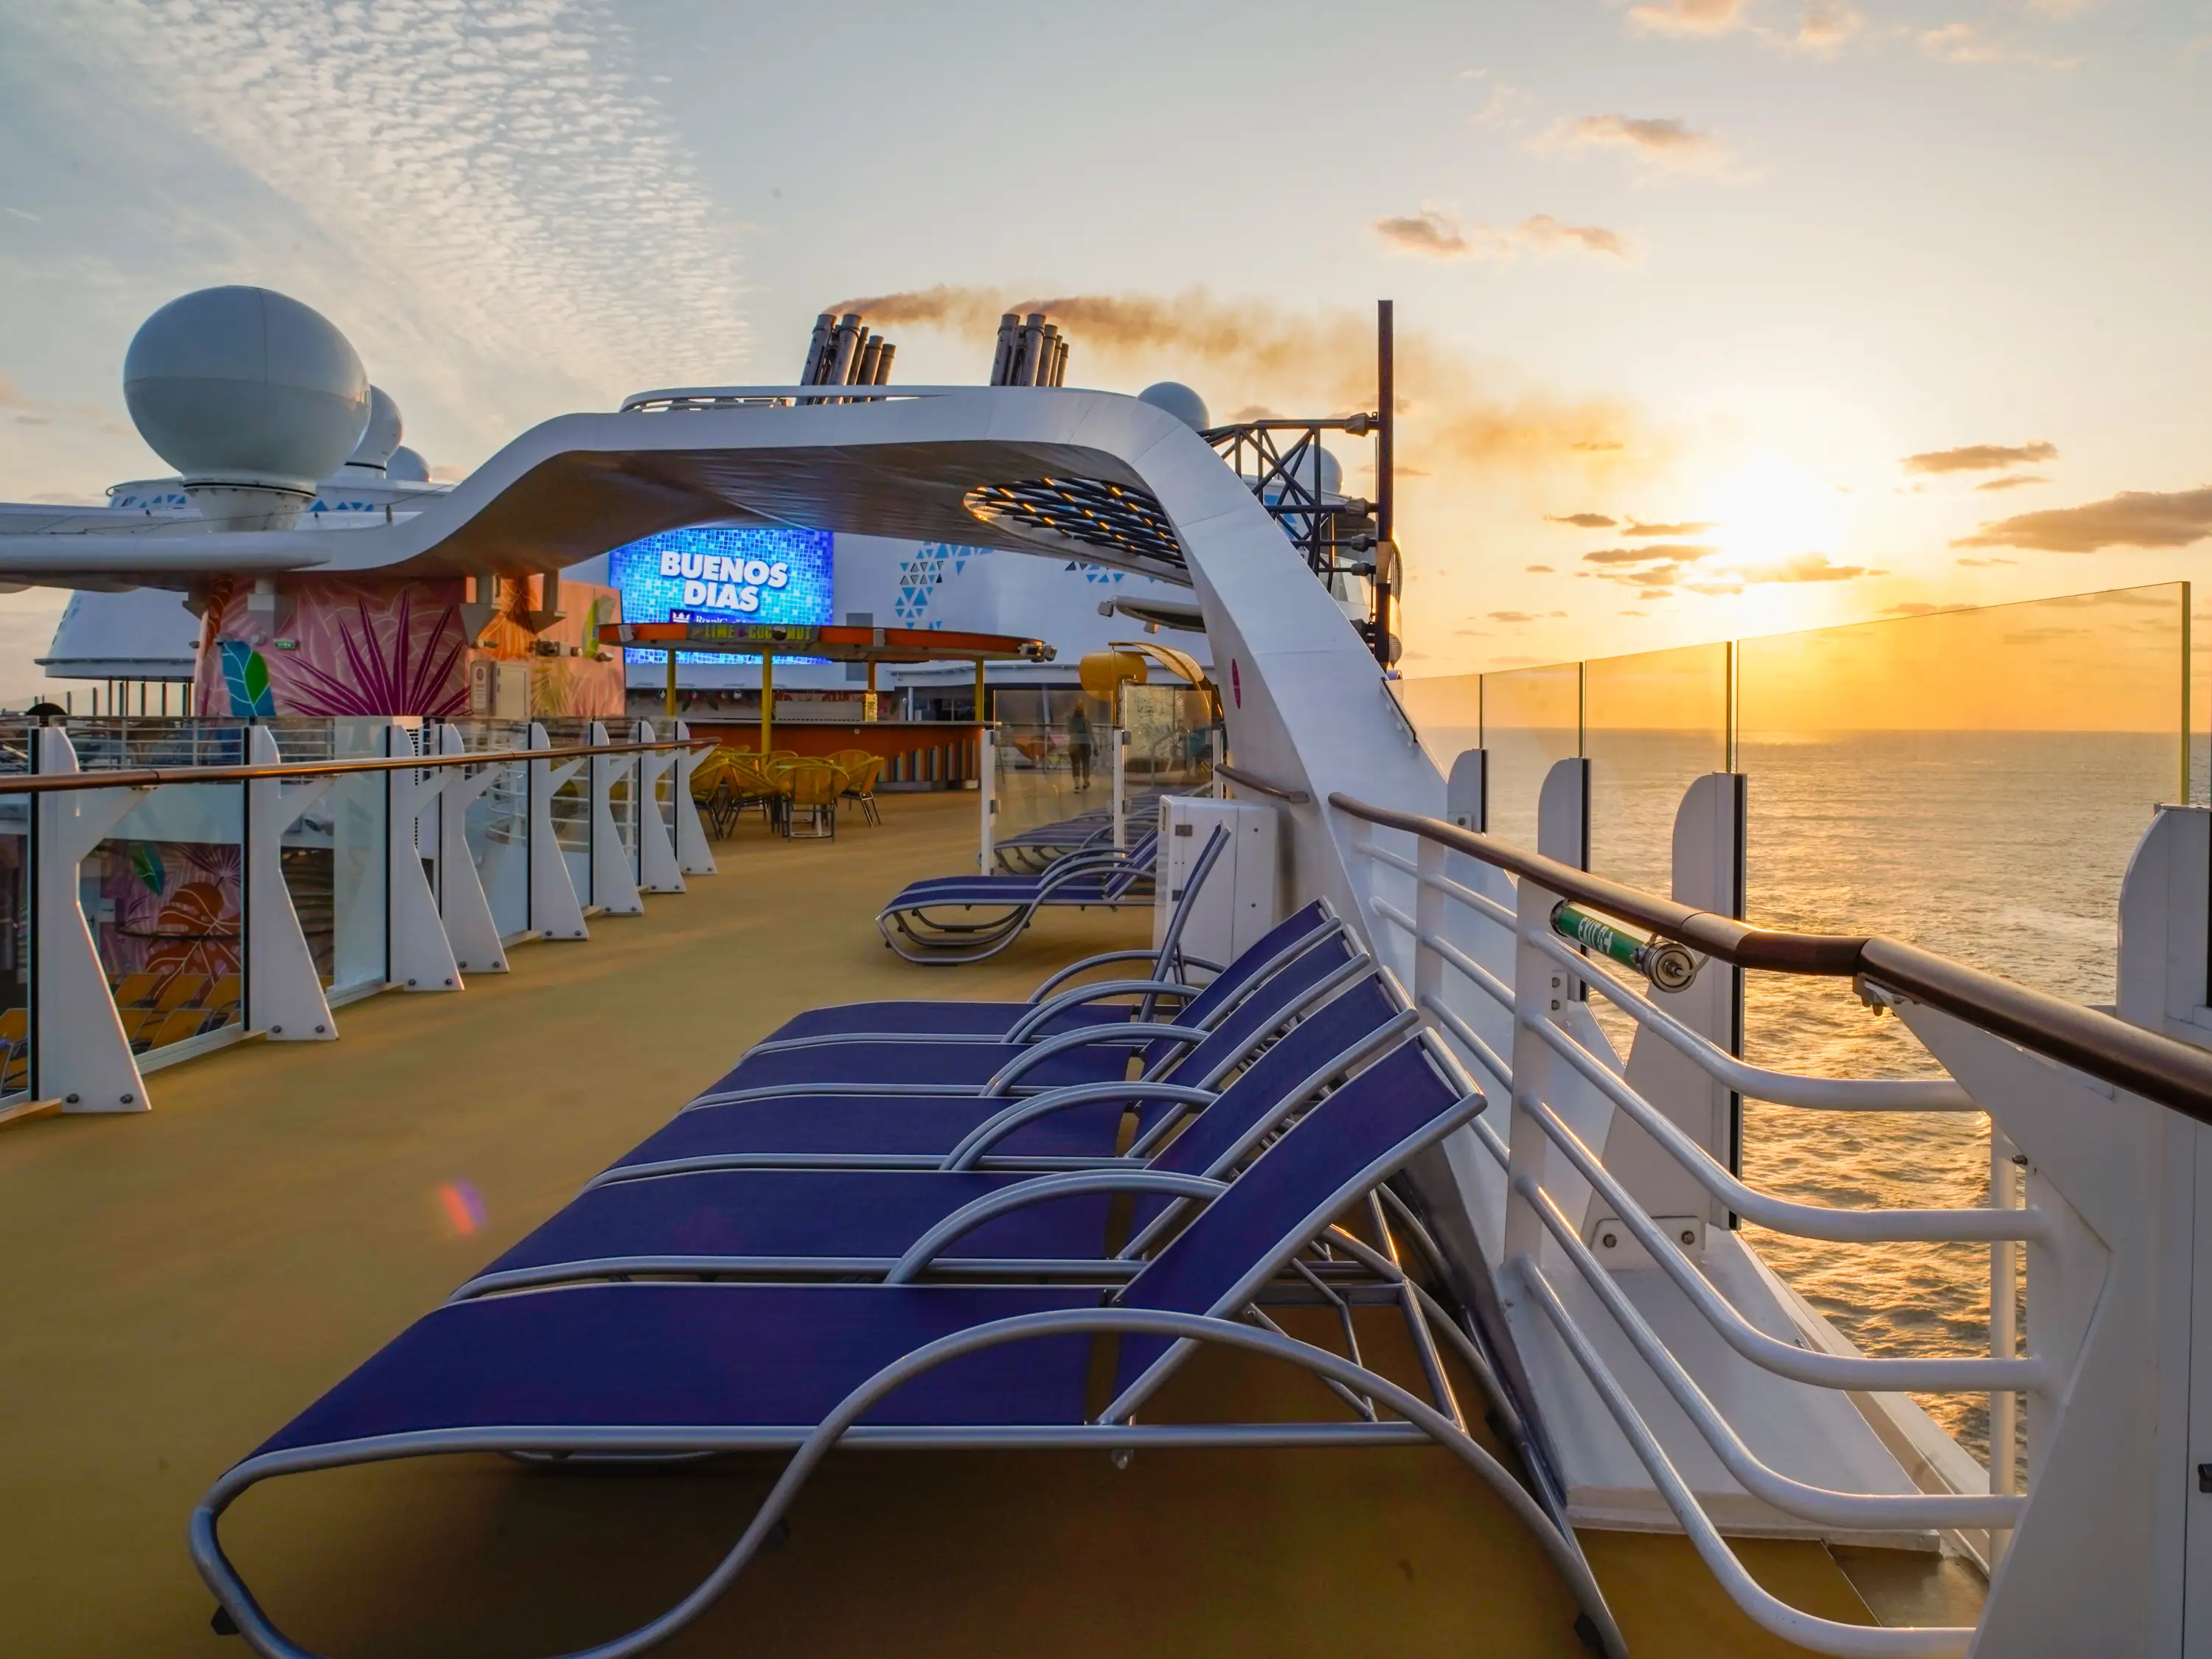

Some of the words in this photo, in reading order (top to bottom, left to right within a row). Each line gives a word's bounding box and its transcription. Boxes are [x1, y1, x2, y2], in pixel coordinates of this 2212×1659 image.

[660, 551, 788, 588] BUENOS
[684, 580, 759, 612] DIAS
[705, 625, 734, 639] LIME
[1578, 917, 1601, 948] EXIT
